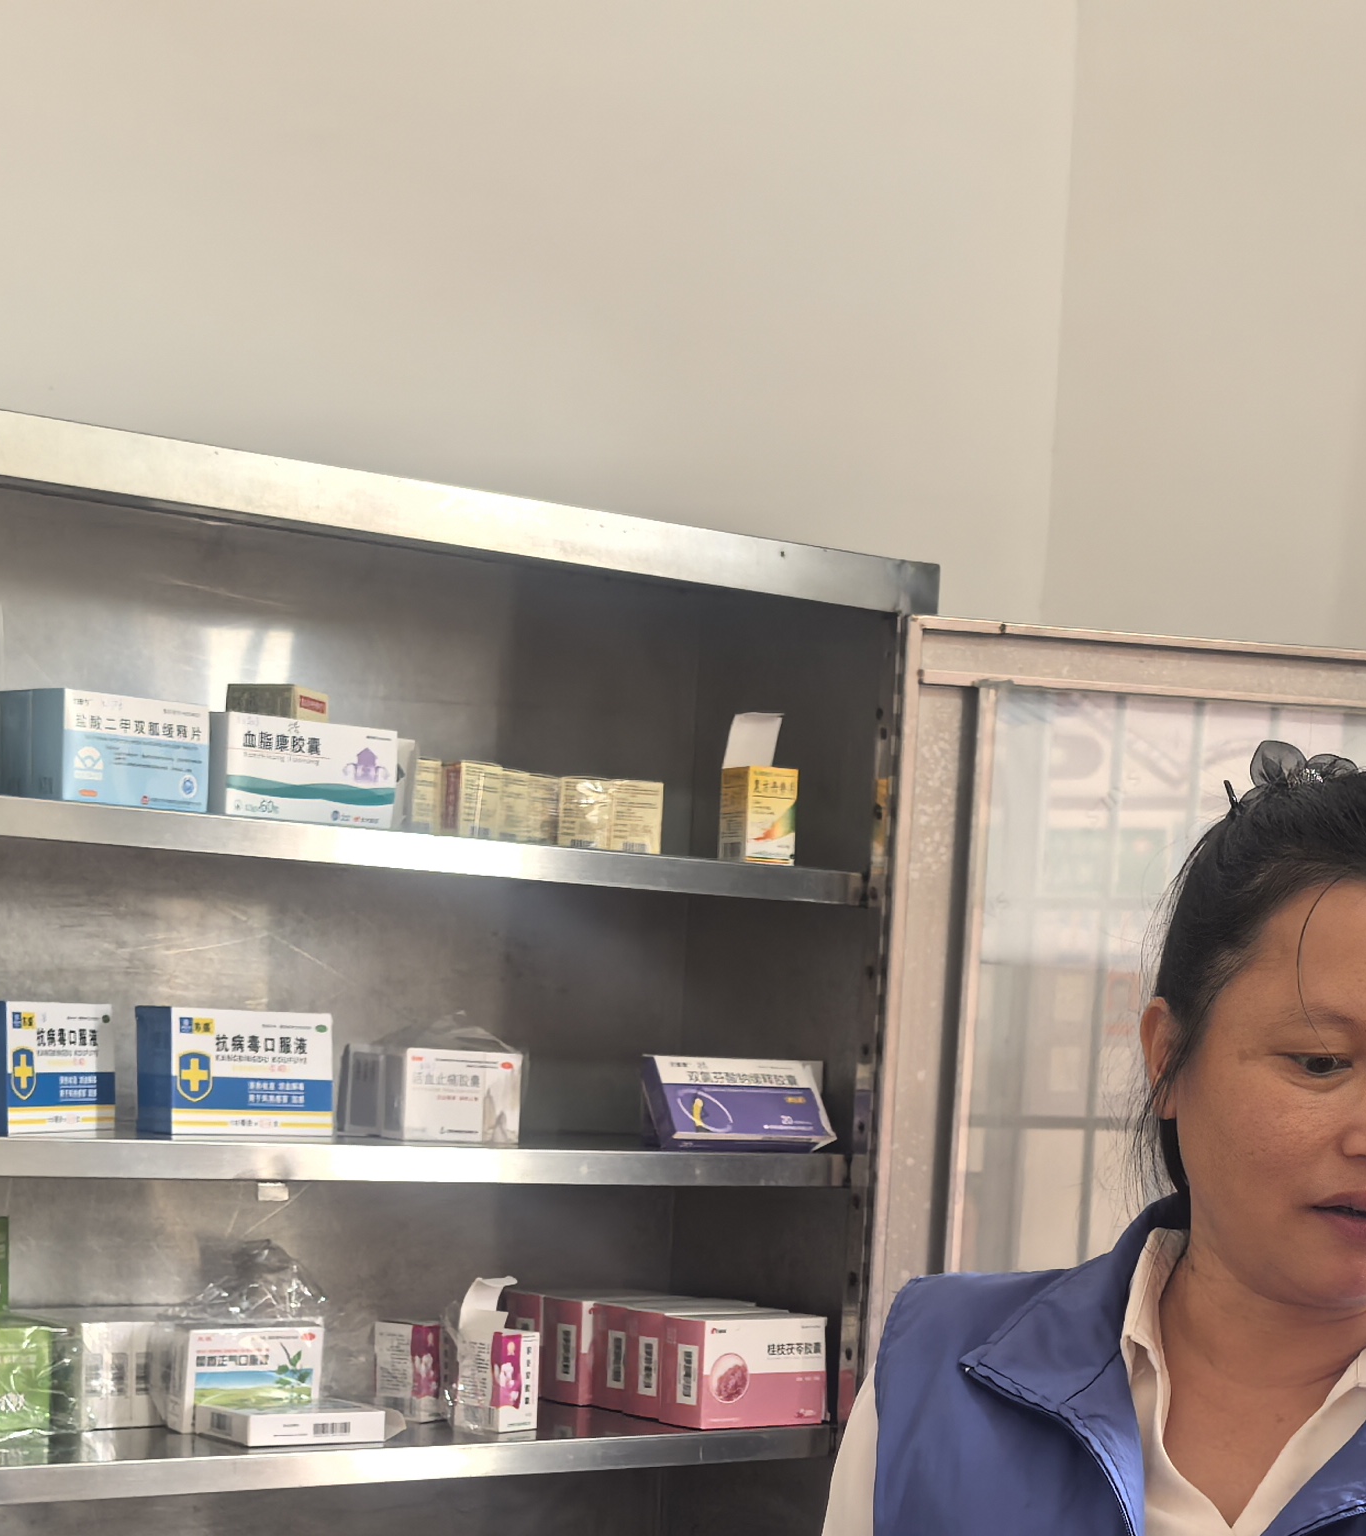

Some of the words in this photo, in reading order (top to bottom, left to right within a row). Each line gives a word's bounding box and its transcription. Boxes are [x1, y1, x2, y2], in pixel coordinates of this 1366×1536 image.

[76, 713, 202, 741] 盐酸二甲双胍缓释片
[243, 730, 322, 756] 血脂康胶囊
[36, 1028, 99, 1047] 抗病毒口服液
[215, 1034, 308, 1055] 抗病毒口服液
[767, 1342, 822, 1356] 桂枝茯苓胶囊
